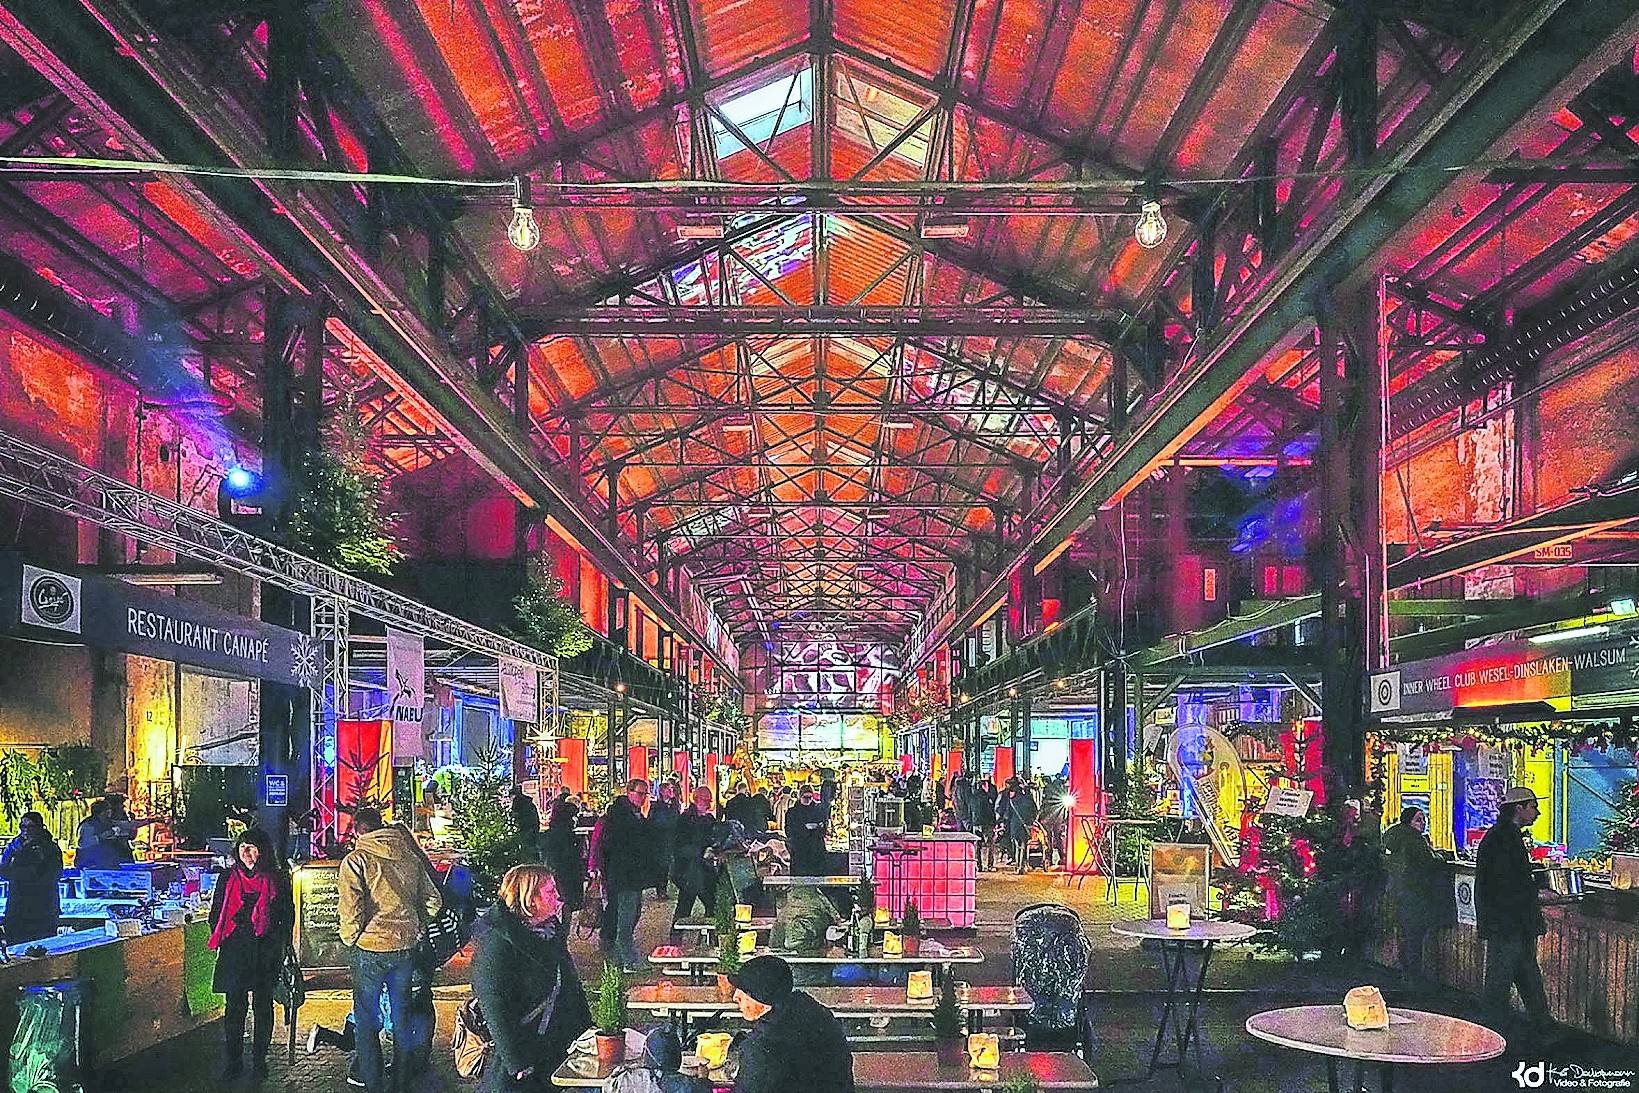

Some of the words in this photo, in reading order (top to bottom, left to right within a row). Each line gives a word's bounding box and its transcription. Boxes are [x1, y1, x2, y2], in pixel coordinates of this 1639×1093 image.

[1535, 546, 1571, 557] SM-035
[127, 607, 219, 652] RESTAURANT
[224, 631, 270, 664] CANAPÉ
[1402, 682, 1424, 696] INNER
[1425, 677, 1452, 692] WHEEL
[1454, 673, 1477, 687] CLUB
[1478, 647, 1626, 685] WESEL-DINSLAKEN-WALSUM
